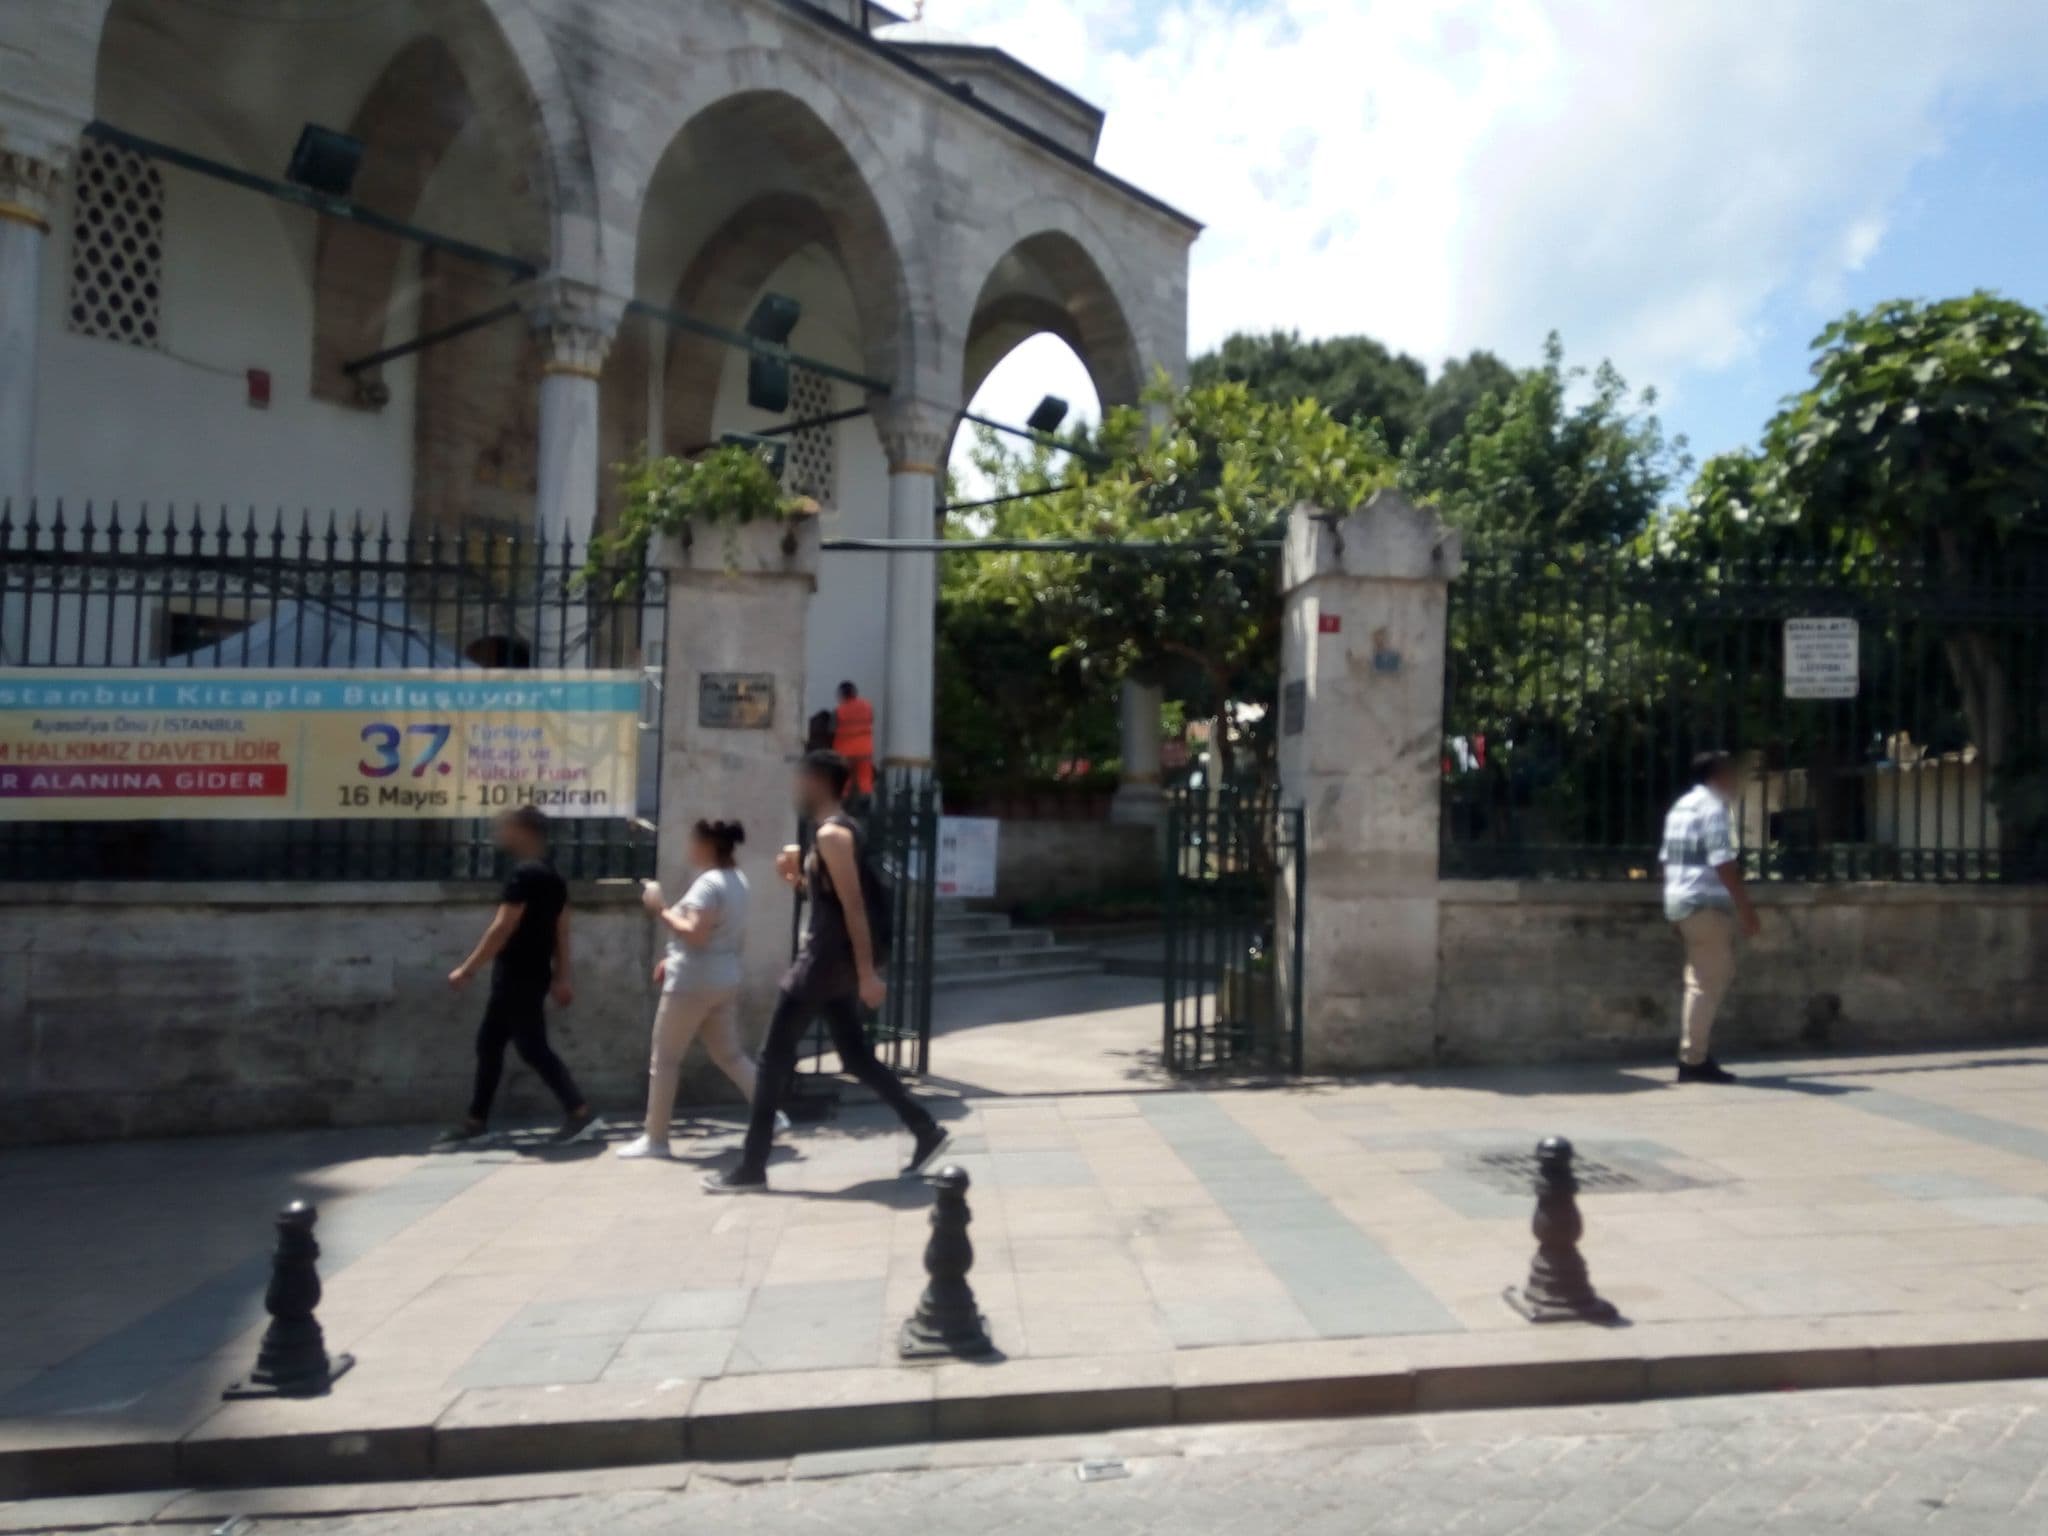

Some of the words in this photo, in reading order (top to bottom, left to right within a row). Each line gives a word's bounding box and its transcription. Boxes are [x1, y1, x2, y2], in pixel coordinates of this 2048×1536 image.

[17, 742, 130, 761] HALKIMIZ
[138, 738, 281, 761] DAVETLİDİR
[358, 722, 452, 778] 37.
[31, 773, 162, 789] ALANINA
[176, 771, 265, 789] GİDER
[338, 784, 369, 807] 16
[379, 785, 448, 811] Mayıs
[478, 784, 508, 806] 10
[516, 784, 607, 806] Haziran
